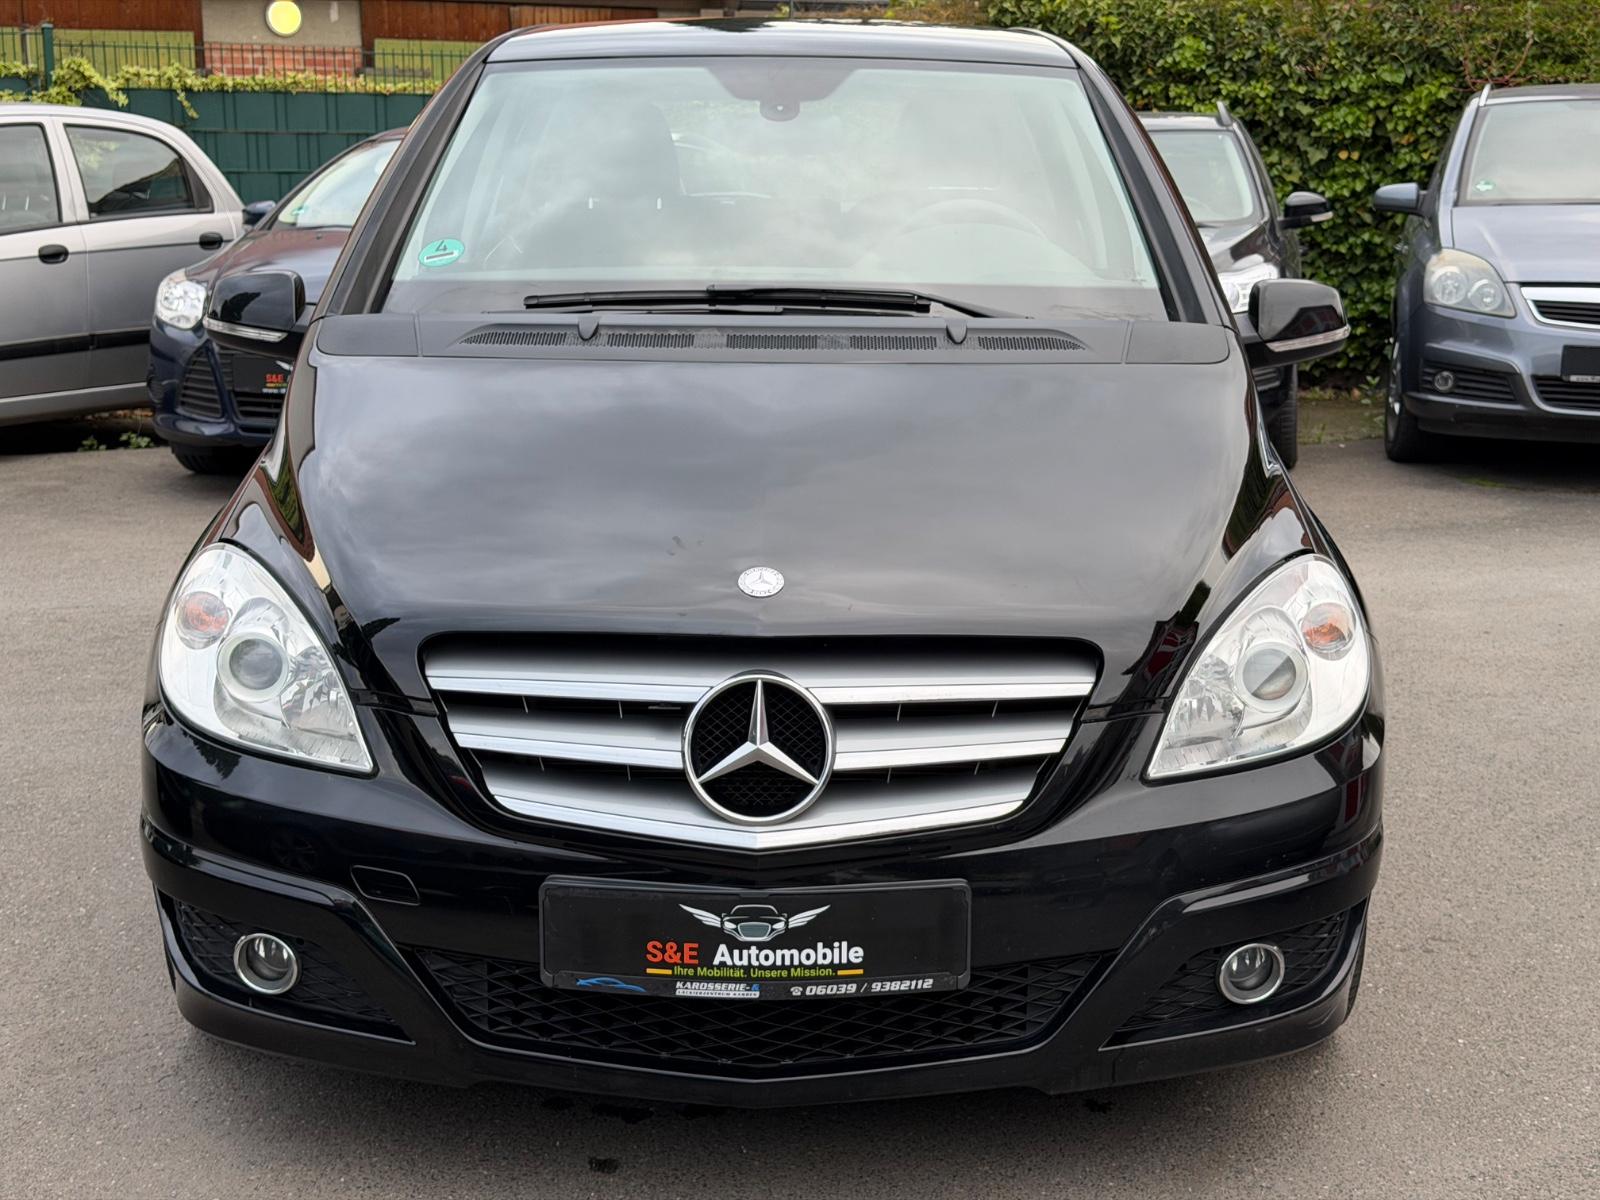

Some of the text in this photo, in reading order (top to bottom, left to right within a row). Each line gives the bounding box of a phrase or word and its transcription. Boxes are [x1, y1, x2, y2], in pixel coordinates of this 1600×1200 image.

[435, 240, 448, 252] 4
[646, 940, 864, 967] S&E Automobile
[674, 965, 836, 978] Ihre Mobilität. Unsere Mission.
[805, 978, 934, 996] 06039 / 9382112
